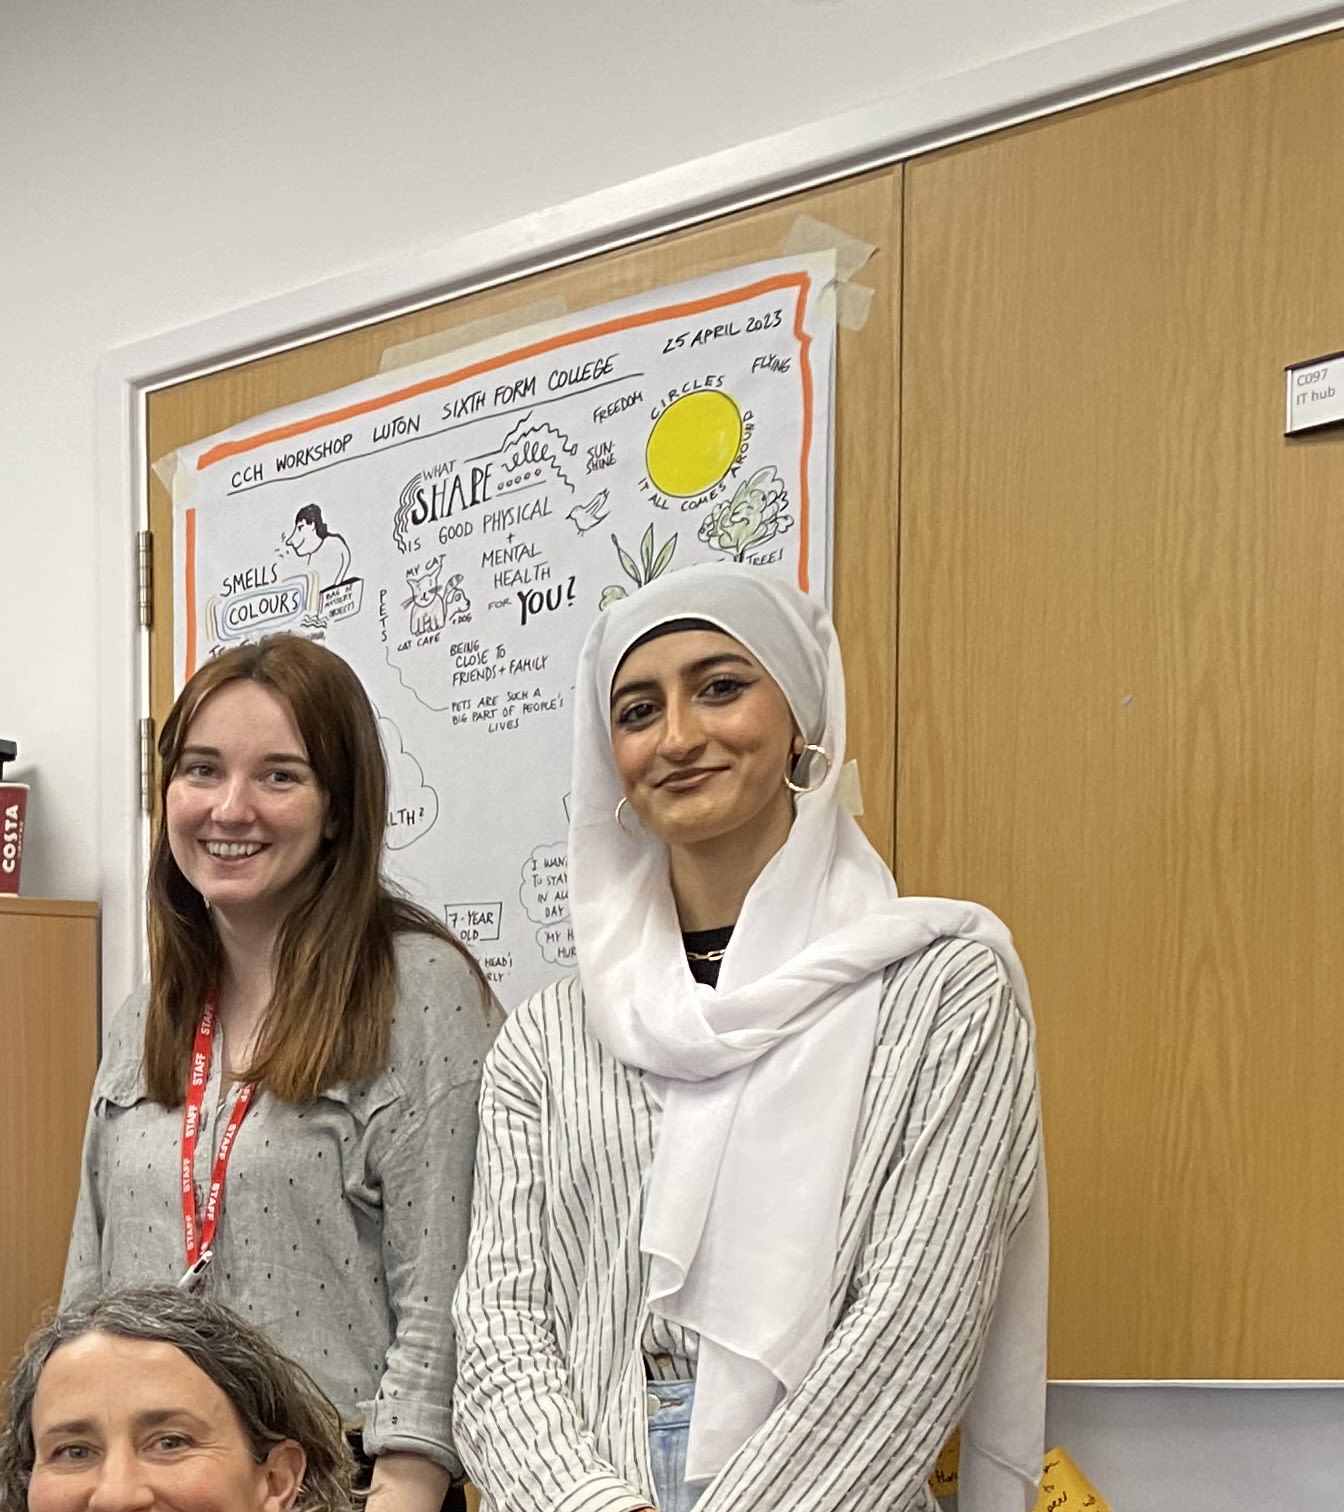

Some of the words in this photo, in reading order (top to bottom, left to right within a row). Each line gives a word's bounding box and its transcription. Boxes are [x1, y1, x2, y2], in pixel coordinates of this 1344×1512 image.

[662, 332, 690, 354] 25
[690, 322, 741, 348] APRIL
[746, 309, 783, 334] 2023
[751, 353, 792, 374] FLYING
[592, 391, 645, 424] FREEDOM
[650, 375, 725, 420] CIRCLES
[1296, 392, 1309, 405] IT
[1311, 385, 1336, 402] hub
[231, 463, 263, 488] CCH
[276, 433, 353, 472] WORKSHOP
[373, 414, 421, 442] LUTON
[442, 390, 486, 420] SIXTH
[493, 376, 536, 406] FORM
[548, 353, 620, 391] COLLEGE
[422, 460, 457, 480] WHAT
[585, 454, 617, 475] SHINE
[637, 477, 652, 492] IT
[648, 493, 671, 510] ALL
[680, 483, 727, 512] COMES
[730, 410, 755, 479] AROUND
[411, 463, 493, 526] SHAPE
[408, 538, 422, 552] IS
[439, 522, 473, 544] GOOD
[482, 496, 553, 533] PHYSICAL
[405, 563, 420, 577] MY
[425, 554, 447, 571] CAT
[481, 543, 542, 568] MENTAL
[220, 563, 278, 597] SMELLS
[493, 561, 551, 589] HEALTH
[229, 591, 299, 625] COLOURS
[379, 589, 389, 642] PETS
[487, 598, 512, 611] FOR
[397, 640, 412, 651] CAT
[417, 632, 441, 647] CAFE
[450, 640, 480, 656] BEING
[455, 648, 489, 668] CLOSE
[496, 643, 506, 659] TO
[452, 664, 497, 687] FRIENDS
[509, 654, 549, 676] FAMILY
[451, 699, 472, 712] PETS
[477, 696, 499, 709] ARE
[506, 690, 528, 702] SUCH
[533, 687, 542, 698] A
[451, 713, 468, 726] BIG
[472, 708, 498, 722] PART
[502, 705, 515, 718] OF
[488, 718, 520, 734] LIVES
[385, 806, 425, 828] LTH?
[2, 804, 19, 874] COSTA
[532, 859, 538, 871] I
[532, 874, 543, 888] TO
[538, 891, 549, 904] IN
[545, 905, 564, 918] DAY
[460, 929, 480, 942] OLD
[193, 1052, 206, 1087] STAFF
[185, 1104, 198, 1138] STAFF
[219, 1123, 237, 1160] STAFF
[182, 1158, 191, 1193] STAFF
[207, 1183, 221, 1221] STAFF
